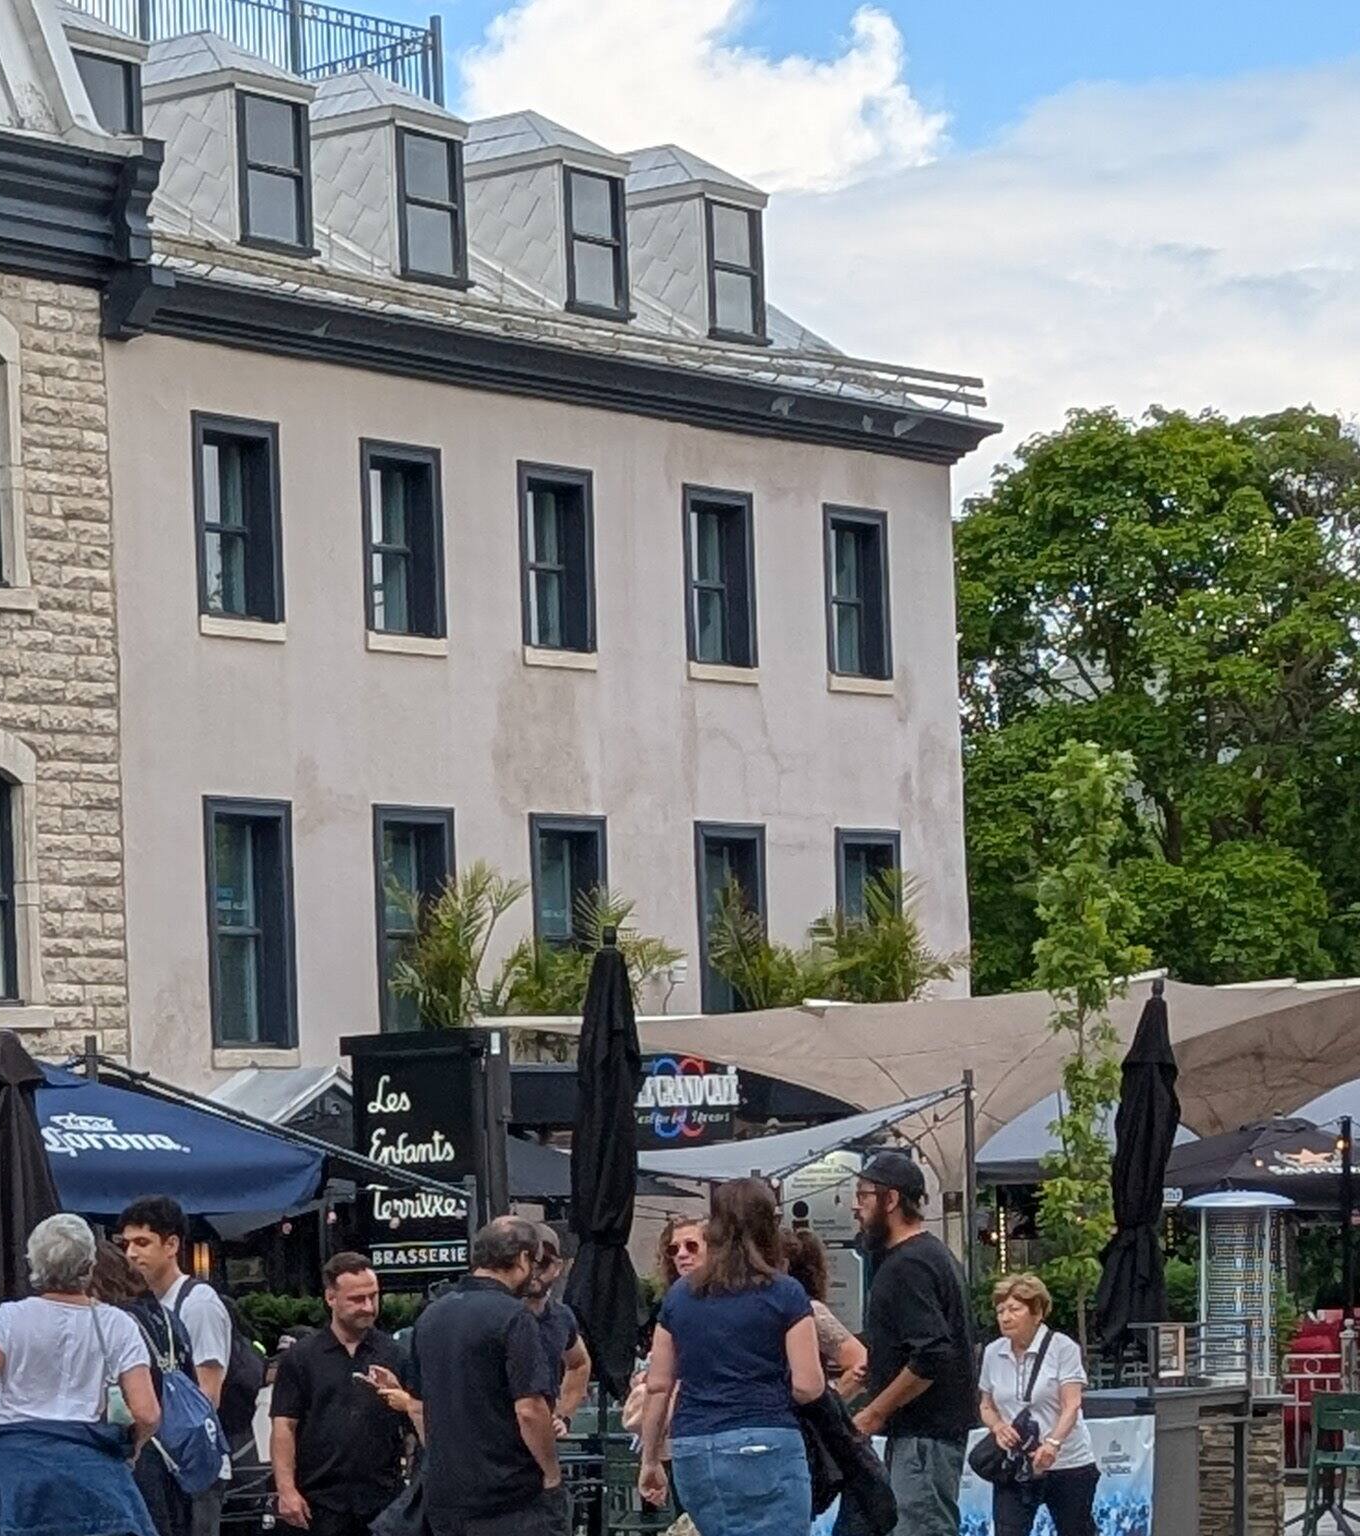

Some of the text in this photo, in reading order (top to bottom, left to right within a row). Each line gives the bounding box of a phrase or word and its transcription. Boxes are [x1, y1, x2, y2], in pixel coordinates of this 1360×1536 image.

[367, 1075, 411, 1113] Les
[369, 1128, 455, 1165] Enfants
[373, 1246, 468, 1266] BRASSERIE
